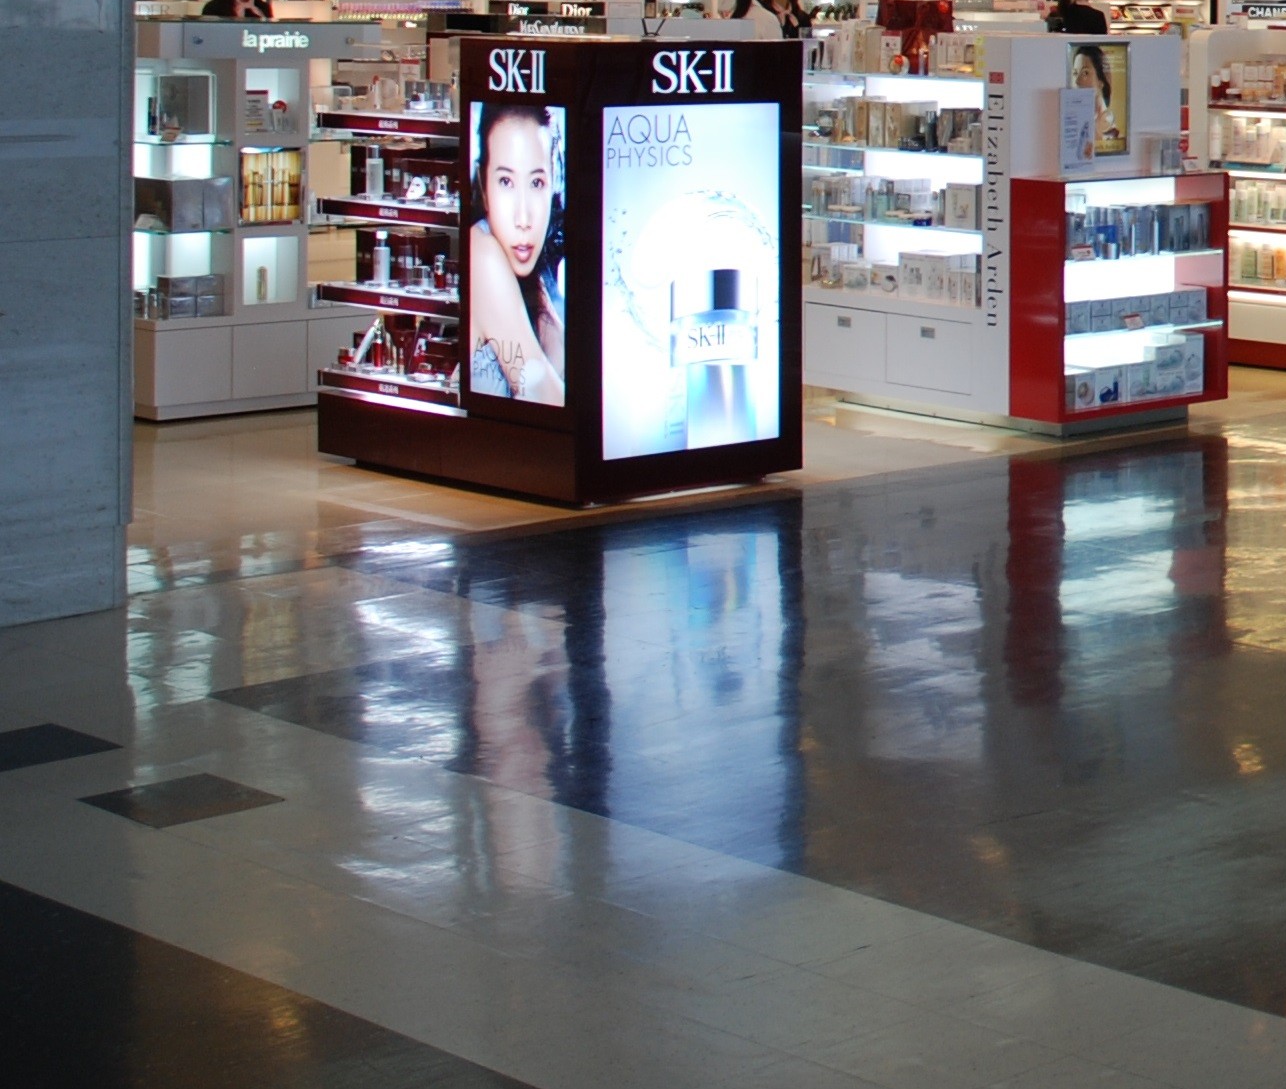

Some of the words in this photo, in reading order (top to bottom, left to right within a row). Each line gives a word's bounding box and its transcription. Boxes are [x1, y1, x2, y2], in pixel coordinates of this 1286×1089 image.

[562, 3, 593, 16] Dior
[243, 29, 258, 48] la
[258, 30, 310, 54] prairie
[488, 48, 546, 94] SK-II
[652, 50, 734, 94] SK-II
[606, 113, 692, 145] AQUA
[606, 145, 694, 169] PHYSICS
[987, 93, 1005, 232] Elizabeth
[986, 242, 1004, 328] Arden
[473, 337, 526, 365] AQUA
[686, 324, 727, 350] SK-II
